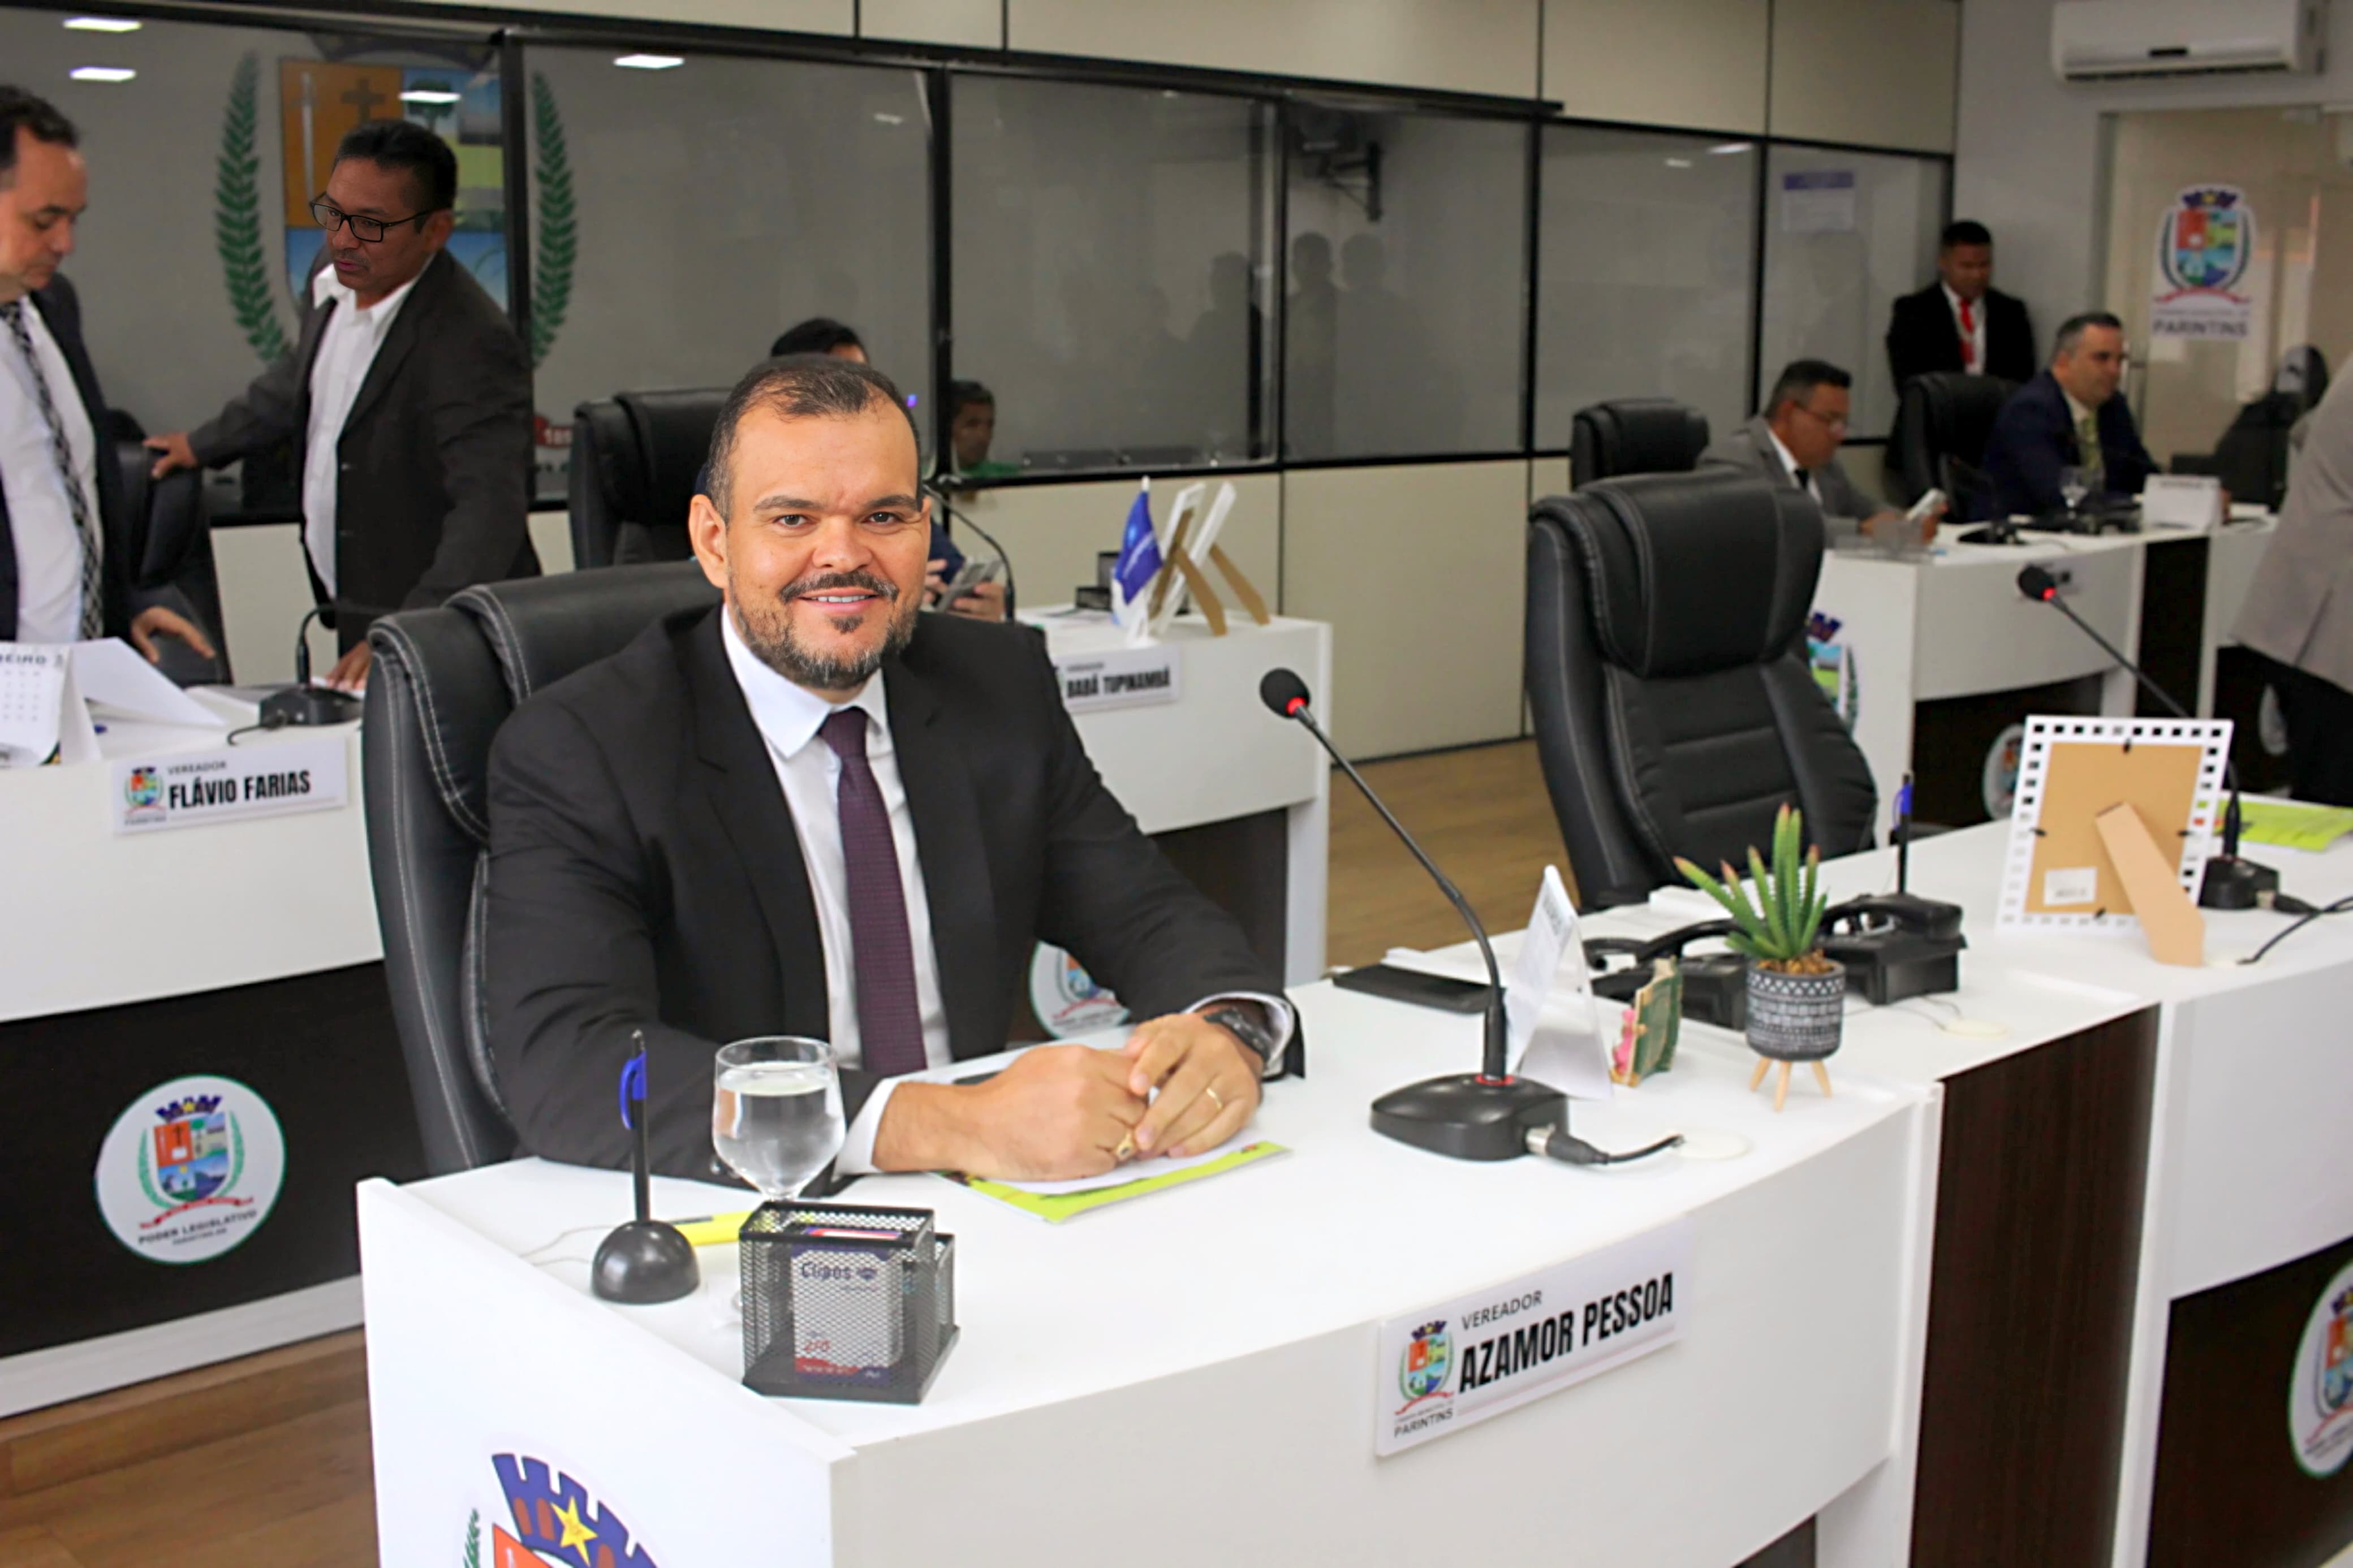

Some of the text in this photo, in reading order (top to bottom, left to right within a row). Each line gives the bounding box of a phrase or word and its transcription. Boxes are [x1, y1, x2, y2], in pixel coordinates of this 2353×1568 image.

[168, 760, 227, 775] VEREADOR
[170, 770, 311, 810] FLÁVIO FARIAS
[139, 1228, 178, 1244] PODER
[1461, 1290, 1542, 1331] VEREADOR
[1459, 1271, 1673, 1394] AZAMOR PESSOA
[1394, 1407, 1453, 1439] PARINTINS
